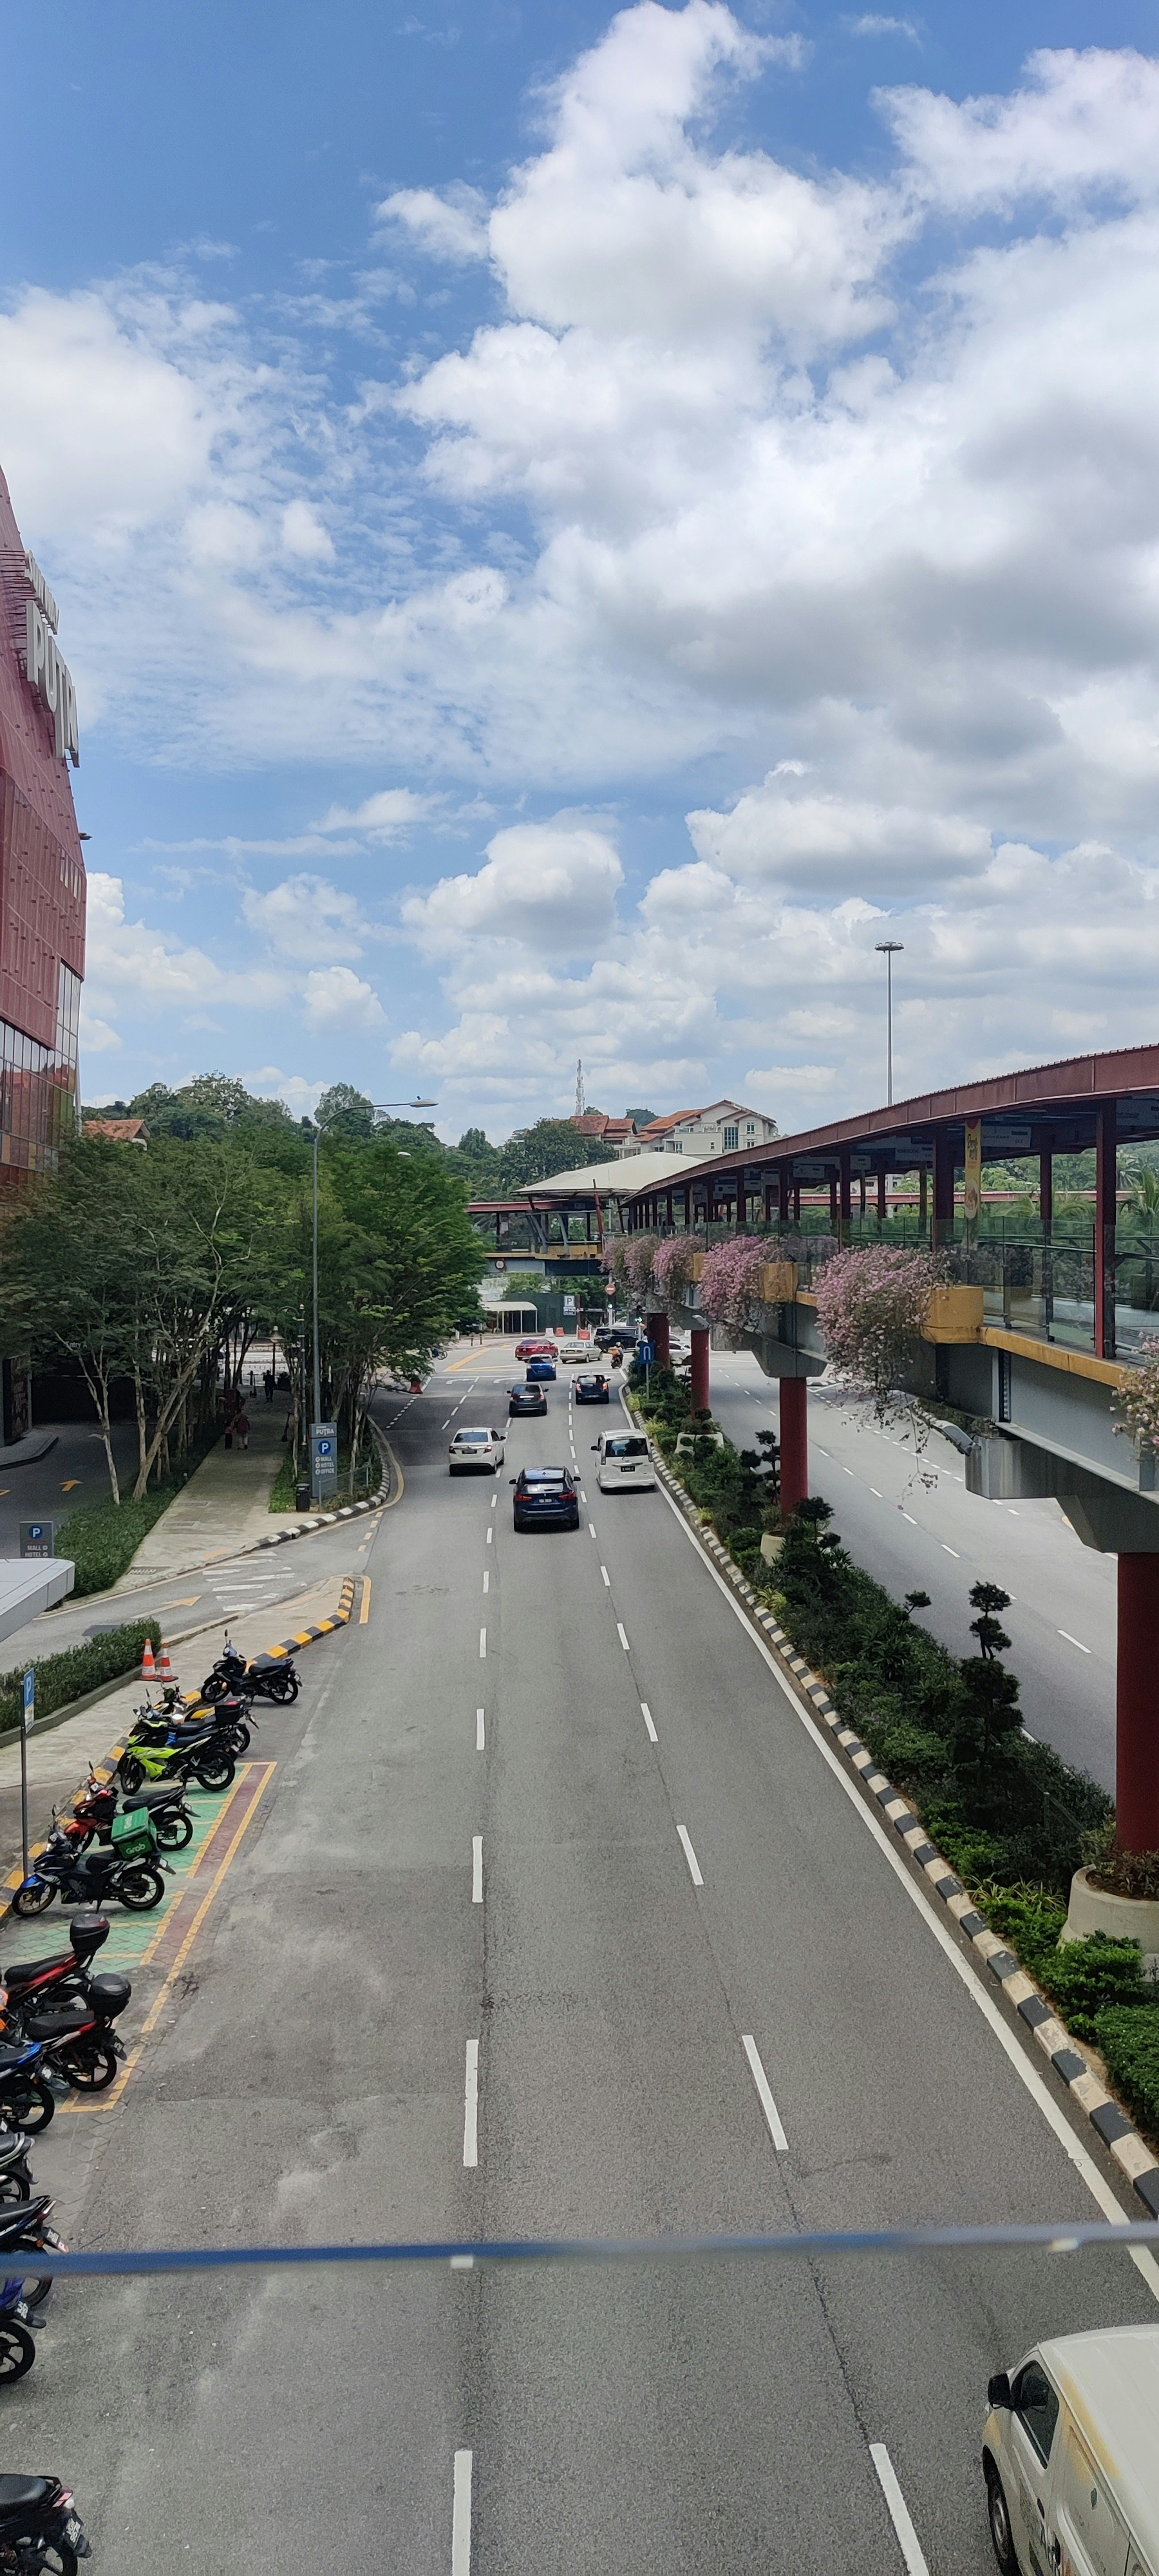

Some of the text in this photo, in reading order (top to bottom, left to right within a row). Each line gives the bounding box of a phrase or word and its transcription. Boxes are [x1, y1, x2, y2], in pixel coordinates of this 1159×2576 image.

[316, 1428, 335, 1436] PUTRA
[322, 1443, 329, 1453] P
[33, 1528, 41, 1537] P
[26, 1676, 31, 1701] P
[126, 1843, 146, 1854] Grab
